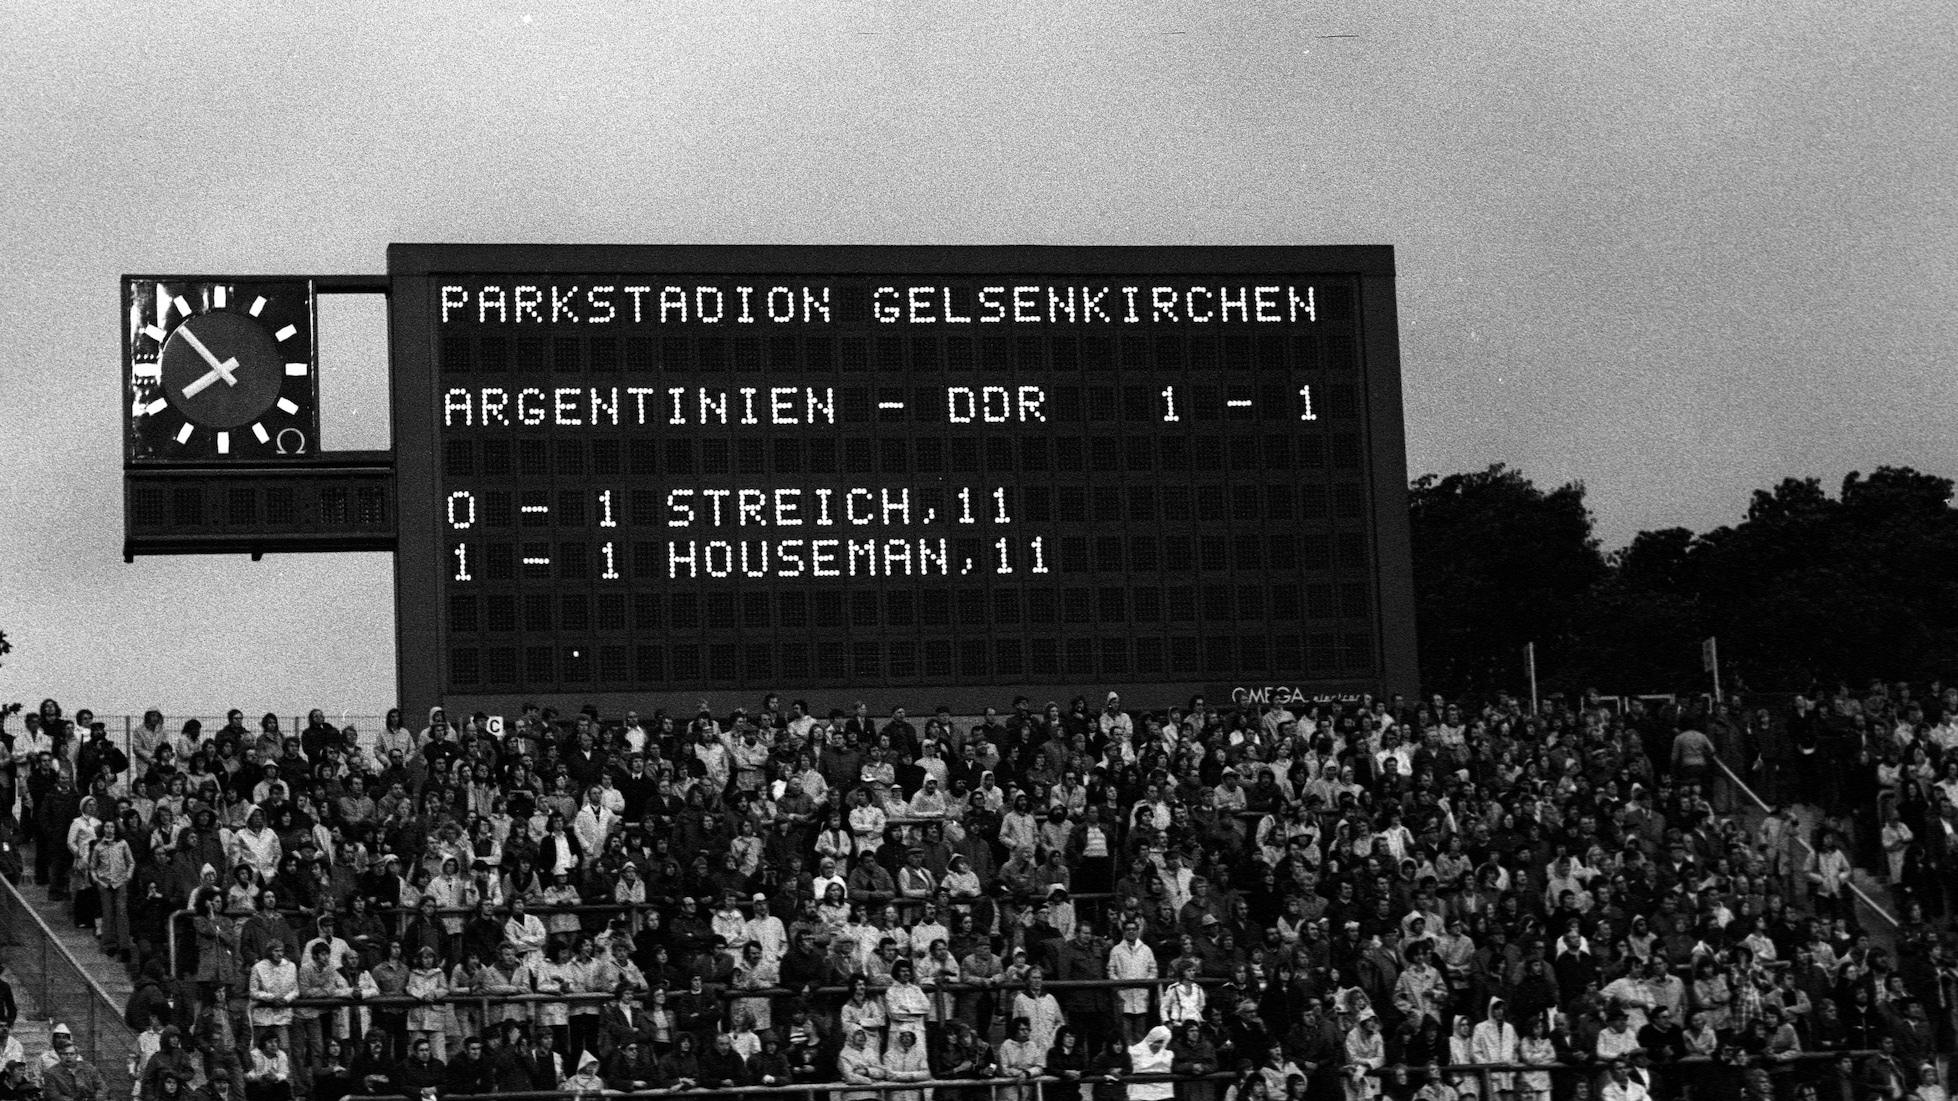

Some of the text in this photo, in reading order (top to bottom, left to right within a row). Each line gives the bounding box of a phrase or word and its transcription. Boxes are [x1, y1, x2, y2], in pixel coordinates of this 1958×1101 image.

[441, 285, 1316, 323] PARKSTADION GELSENKIRCHEN
[444, 386, 835, 426] ARGENTINIEN
[947, 385, 1046, 424] DDR
[1161, 385, 1180, 422] 1
[1299, 384, 1317, 421] 1
[598, 489, 617, 528] 1
[454, 542, 472, 581] 1
[601, 541, 619, 580] 1
